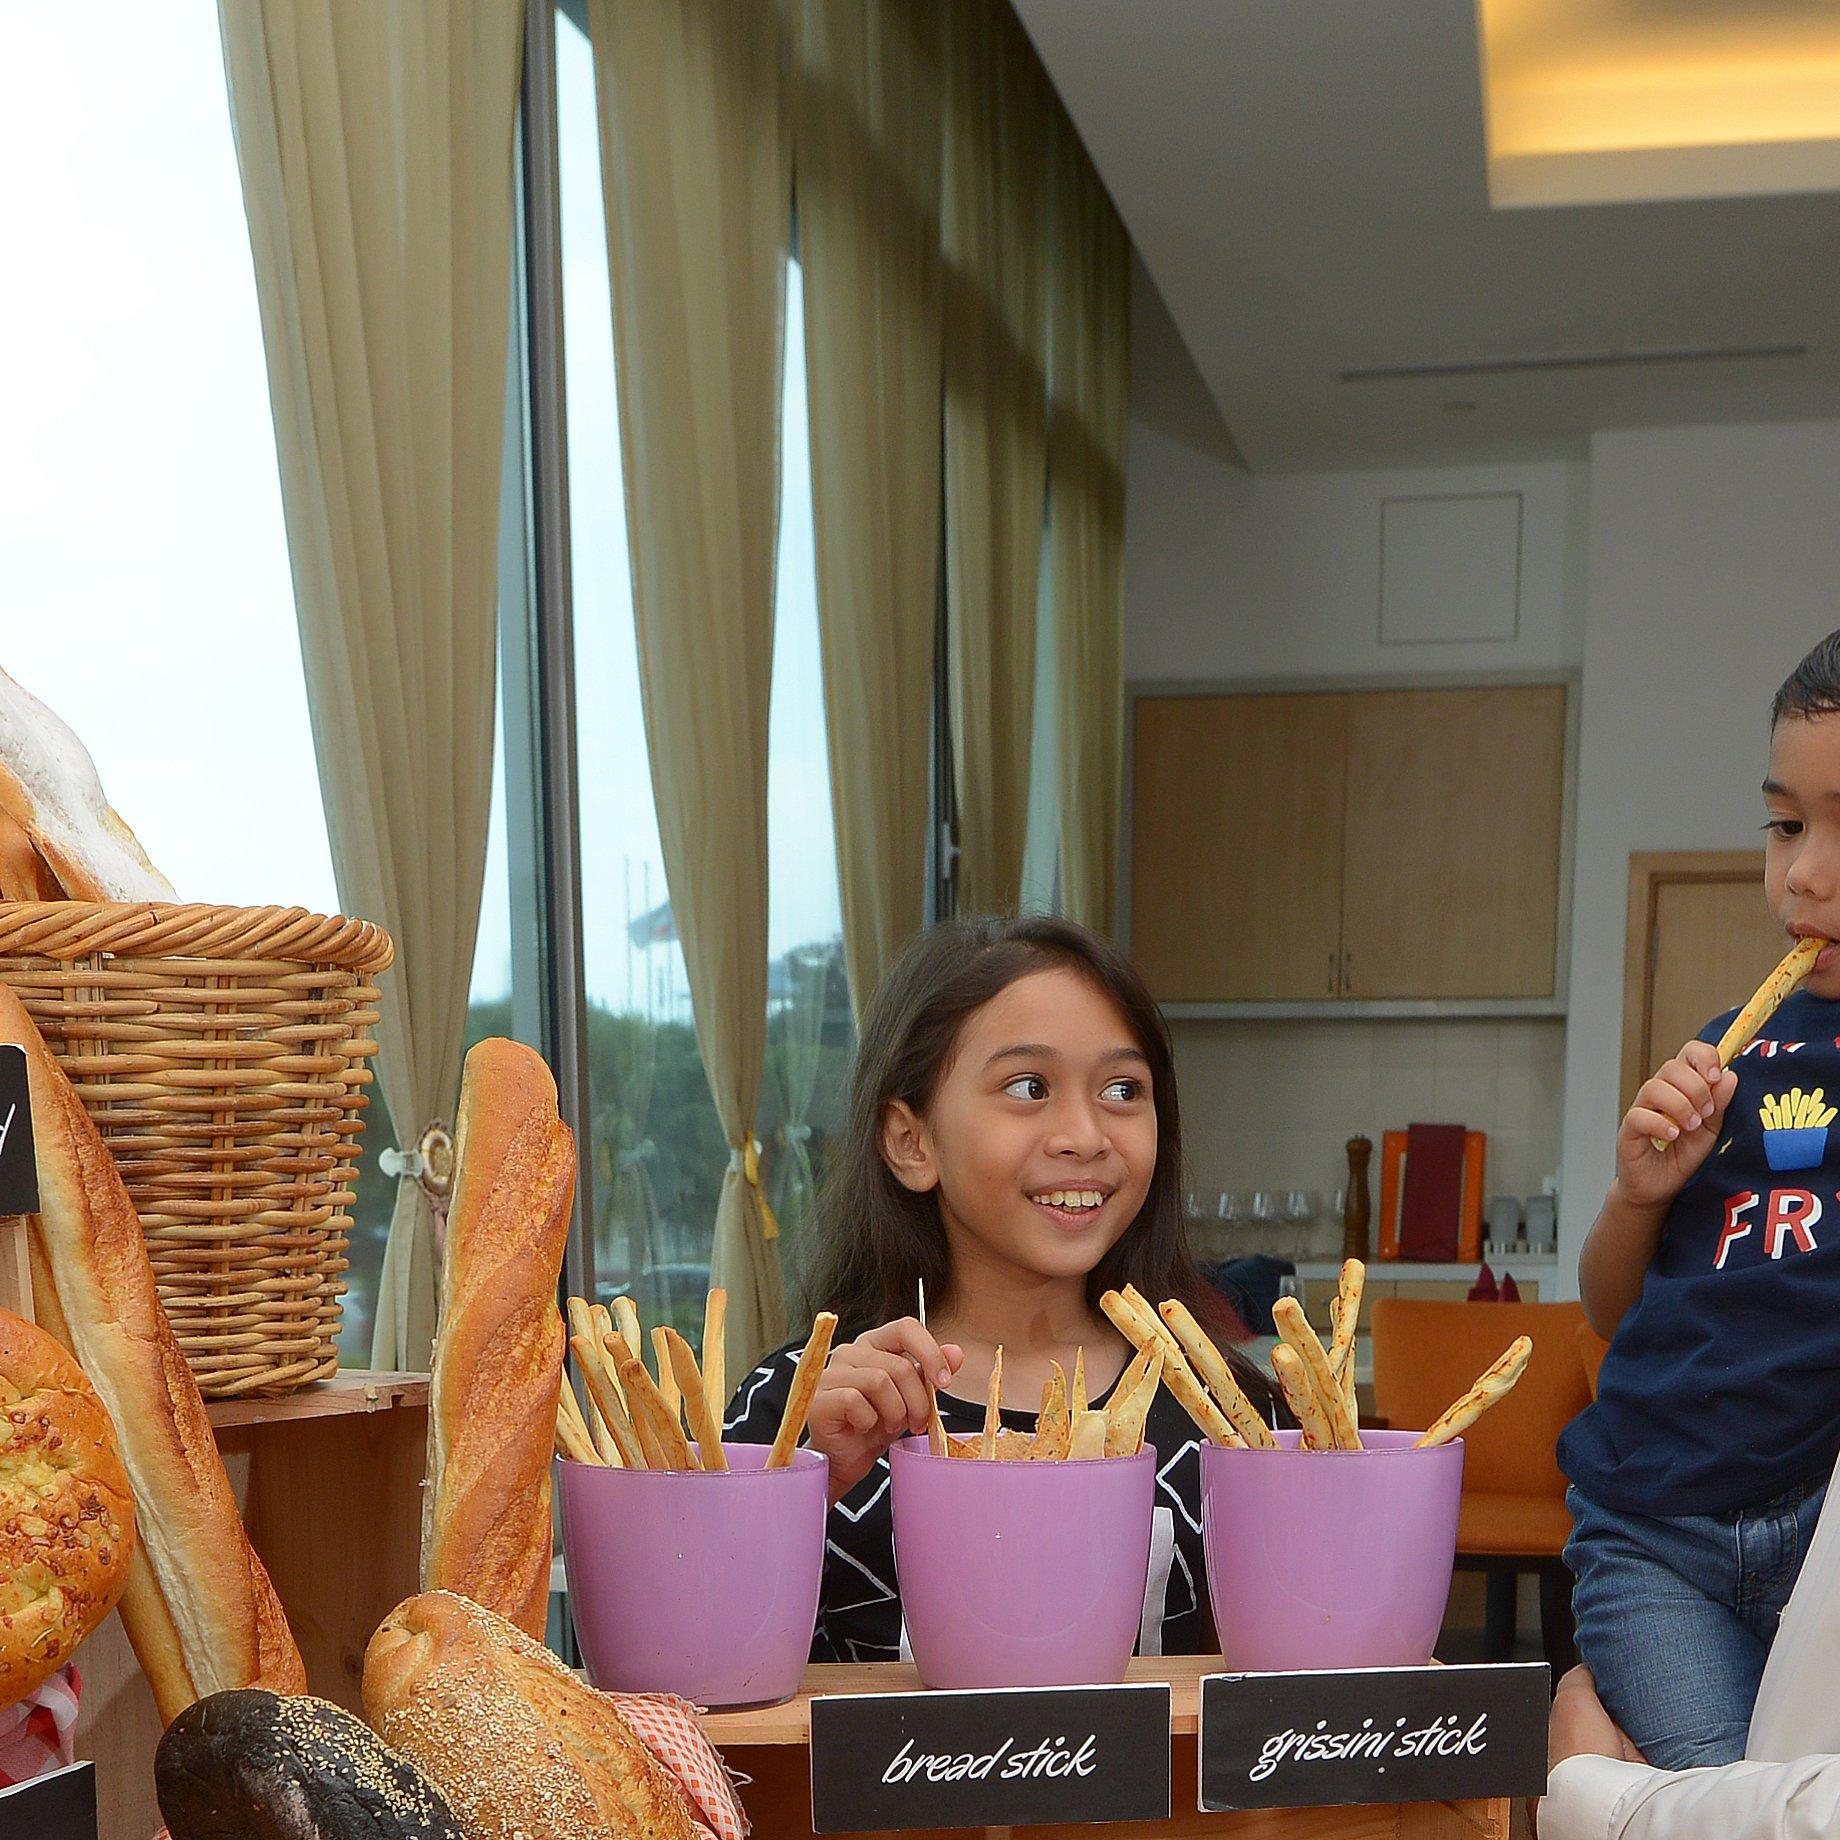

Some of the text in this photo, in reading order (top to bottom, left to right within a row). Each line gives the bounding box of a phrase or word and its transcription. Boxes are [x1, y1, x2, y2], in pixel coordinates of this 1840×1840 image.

[881, 1734, 1097, 1783] bread stick
[1248, 1713, 1488, 1782] grissini stick
